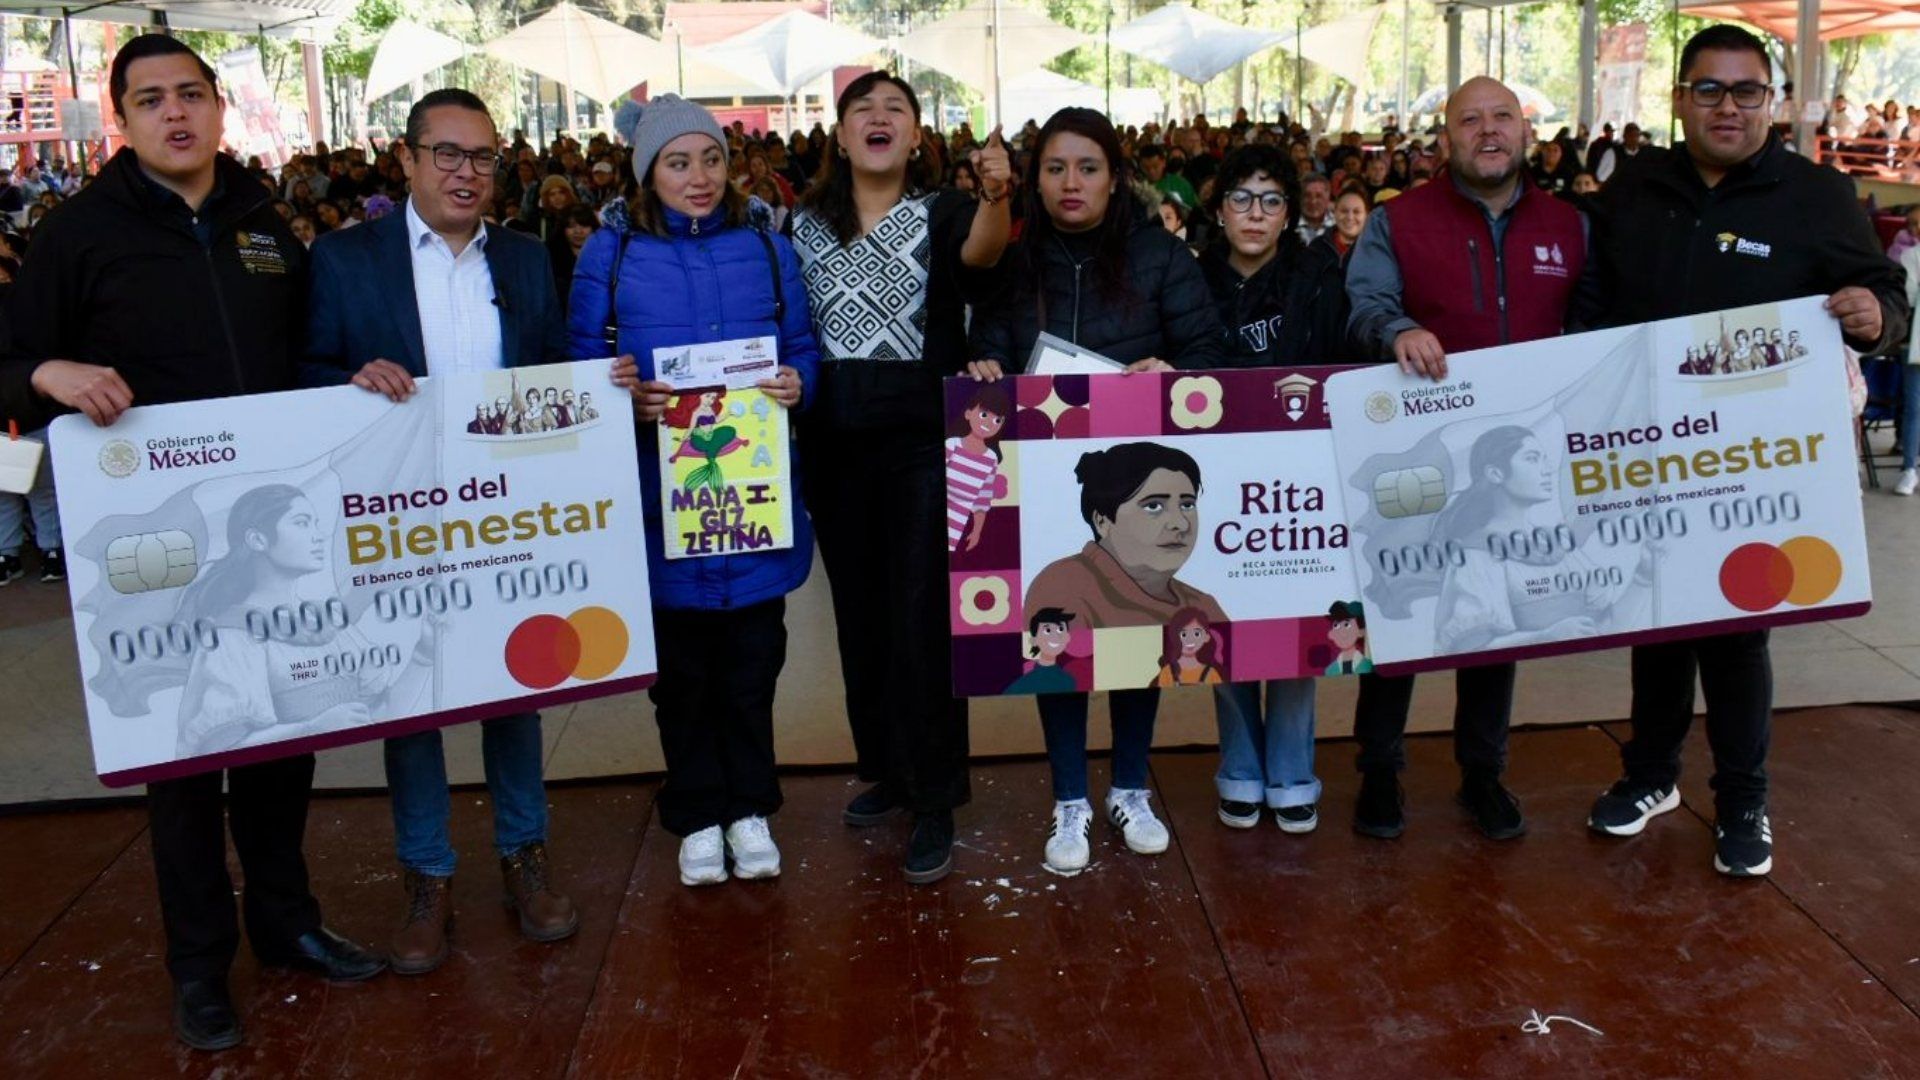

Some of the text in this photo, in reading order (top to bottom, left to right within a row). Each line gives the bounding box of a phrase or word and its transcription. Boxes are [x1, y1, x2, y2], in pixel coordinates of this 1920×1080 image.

[1401, 381, 1472, 399] Gobierno de
[1403, 393, 1475, 416] México
[146, 430, 235, 450] Gobierno de
[1567, 411, 1719, 454] Banco del
[148, 445, 237, 471] México
[1570, 433, 1825, 496] Bienestar
[342, 473, 508, 518] Banco del
[671, 484, 777, 512] MAIA I.
[1241, 479, 1324, 515] Rita
[1578, 483, 1746, 515] El banco de los mexicanos
[345, 499, 614, 565] Bienestar
[682, 521, 773, 555] ZETINA
[1214, 517, 1349, 555] Cetina
[1379, 491, 1800, 577] 0000 0000 0000 0000
[352, 551, 534, 587] El banco de los mexicanos
[1228, 570, 1240, 578] DE
[1242, 558, 1321, 569] BECA UNIVERSAL
[1554, 566, 1623, 593] 00/00
[110, 559, 589, 664] 0000 0000 0000 0000
[289, 659, 319, 671] VALID
[324, 644, 401, 675] 00/00
[291, 670, 318, 681] THRU
